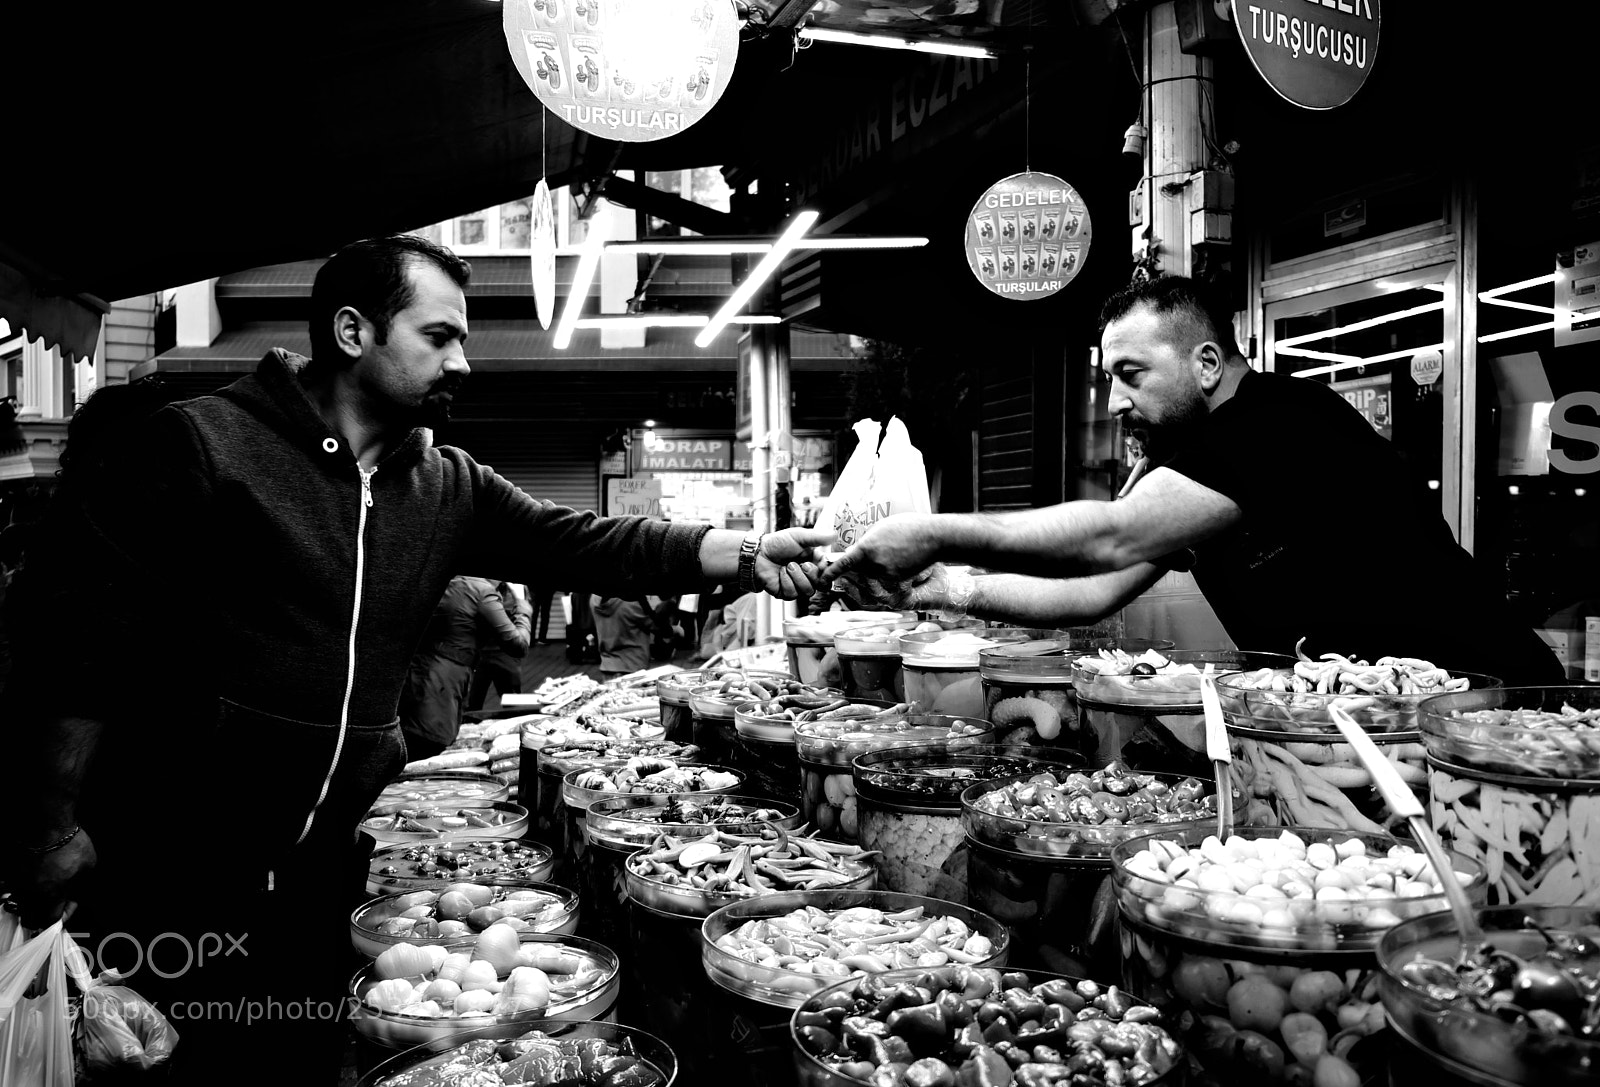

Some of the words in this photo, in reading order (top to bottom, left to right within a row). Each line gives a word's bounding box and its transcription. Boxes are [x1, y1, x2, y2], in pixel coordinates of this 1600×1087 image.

[1249, 6, 1367, 69] TURŞUCUSU
[562, 105, 685, 130] TURŞULARI
[985, 188, 1075, 209] GEDELEK
[995, 281, 1062, 294] TURŞULARI
[1413, 359, 1440, 373] ALARM
